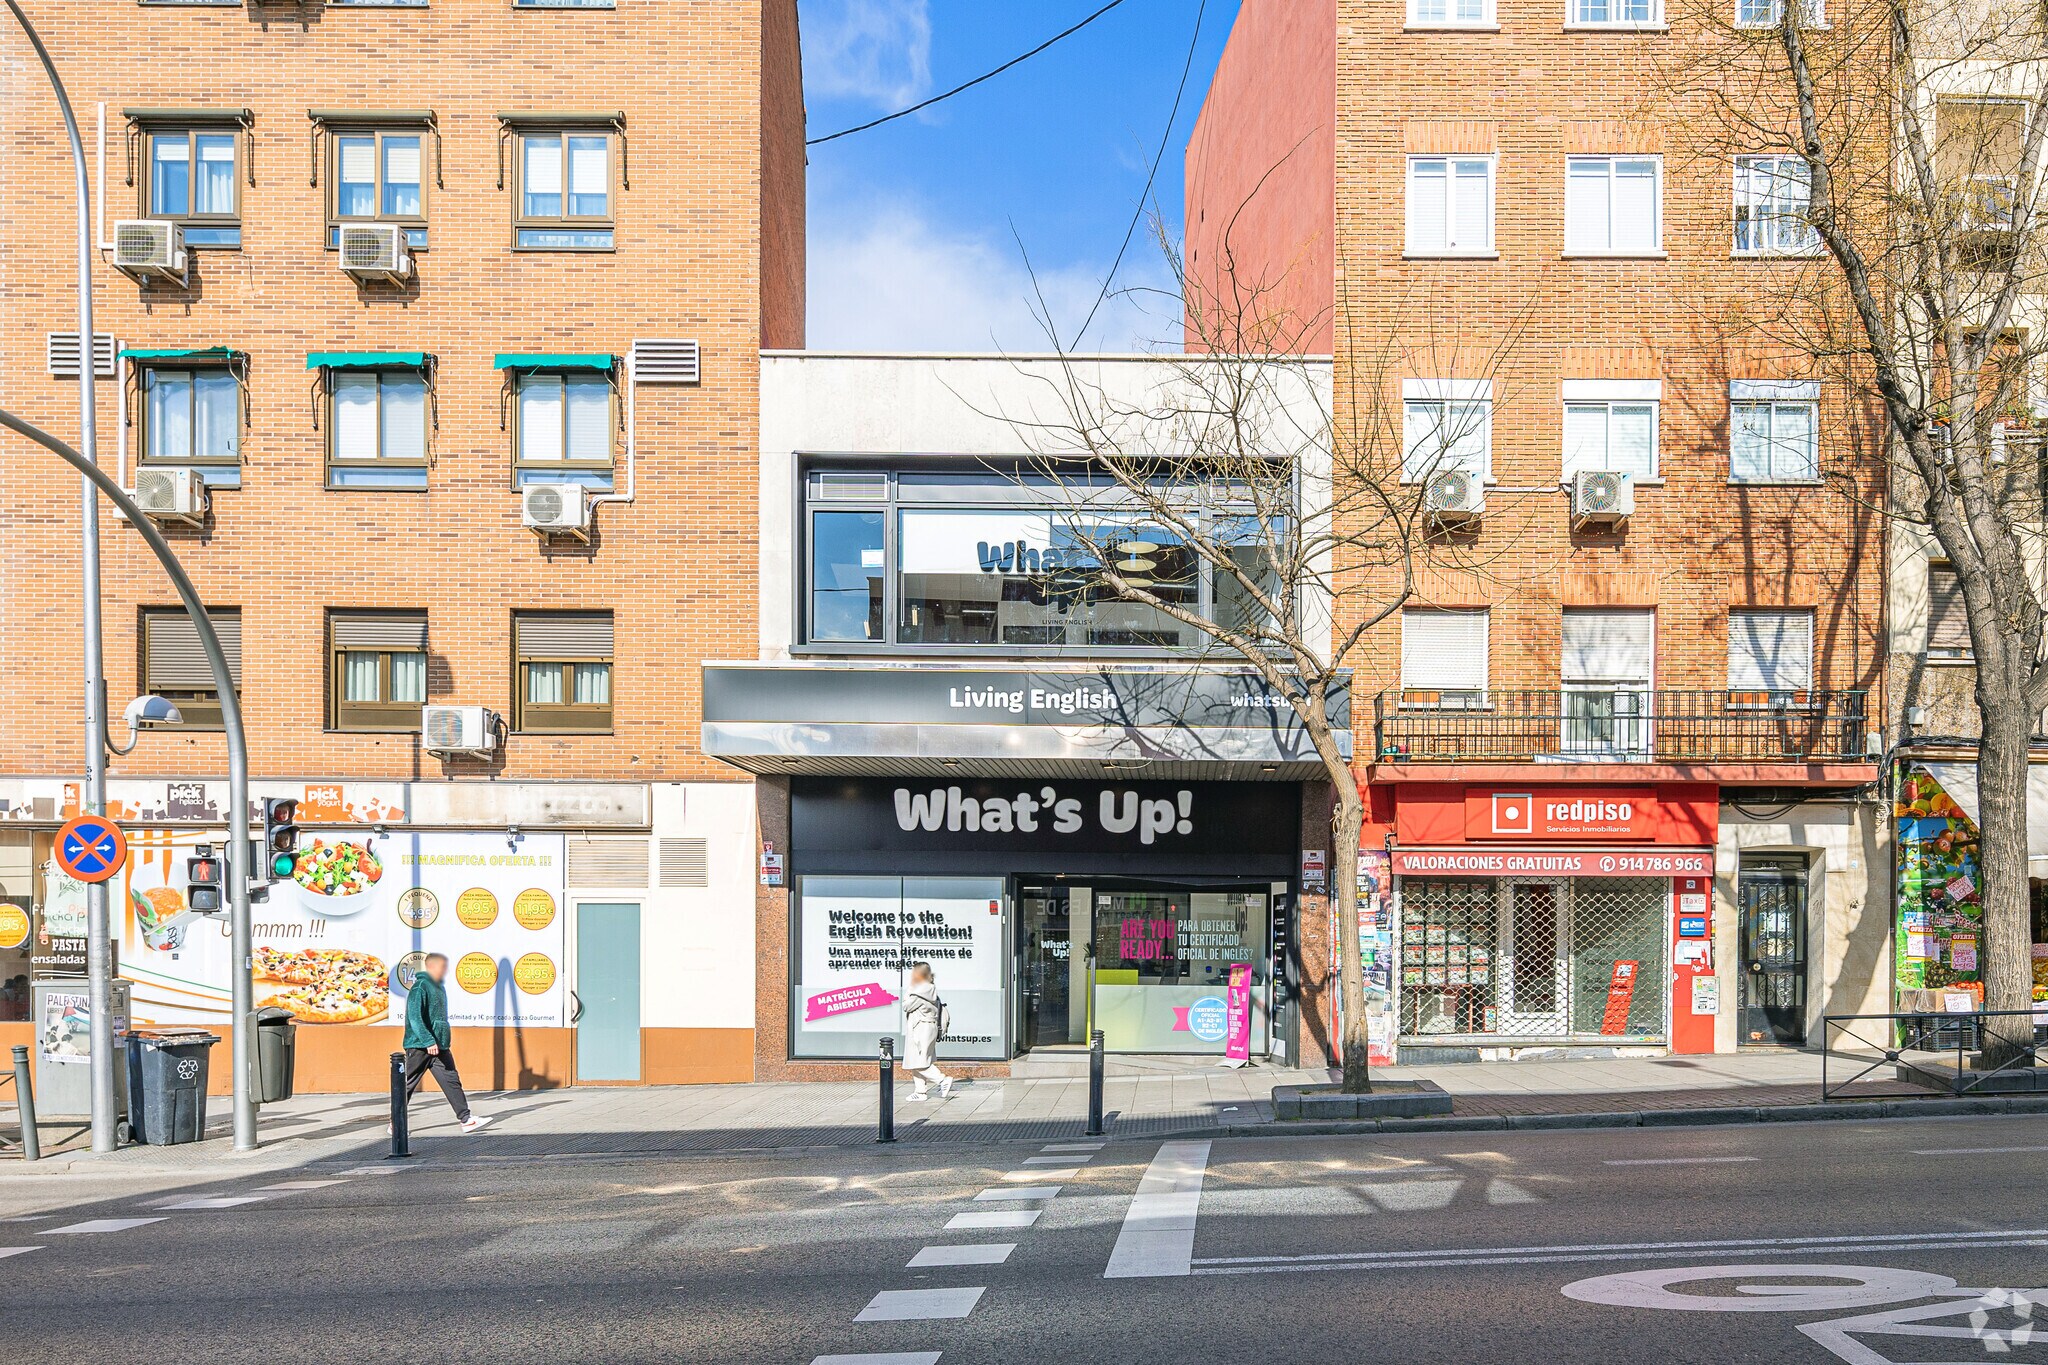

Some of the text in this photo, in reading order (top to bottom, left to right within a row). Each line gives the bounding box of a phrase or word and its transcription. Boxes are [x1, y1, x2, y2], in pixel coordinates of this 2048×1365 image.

[950, 686, 1117, 714] Living English
[308, 787, 338, 802] pick
[894, 786, 1193, 844] What's Up!
[1546, 800, 1632, 823] redpiso
[402, 855, 552, 866] !!! MAGNIFICA OFERTA !!!
[1403, 856, 1702, 871] VALORACIONES GRATUITAS 914 786 966
[828, 910, 895, 923] Welcome
[918, 910, 944, 923] the
[221, 919, 326, 937] Ummm !!!
[828, 924, 972, 940] English Revolution!
[1121, 919, 1175, 939] ARE YOU
[1178, 920, 1236, 932] PARA OBTENER
[52, 939, 86, 951] PASTA
[1040, 940, 1073, 948] What's
[1177, 934, 1239, 946] TU CERTIFICADO
[828, 946, 972, 959] Una manera diferente de
[1053, 949, 1070, 958] Up!
[1120, 940, 1173, 959] READY...
[1177, 946, 1253, 960] OFICIAL DE INGLÉS?
[31, 955, 86, 964] ensaladas
[828, 958, 882, 970] aprender
[48, 995, 90, 1008] PALESTIN
[817, 987, 872, 1005] MATRÍCULA
[827, 997, 867, 1013] ABIERTA
